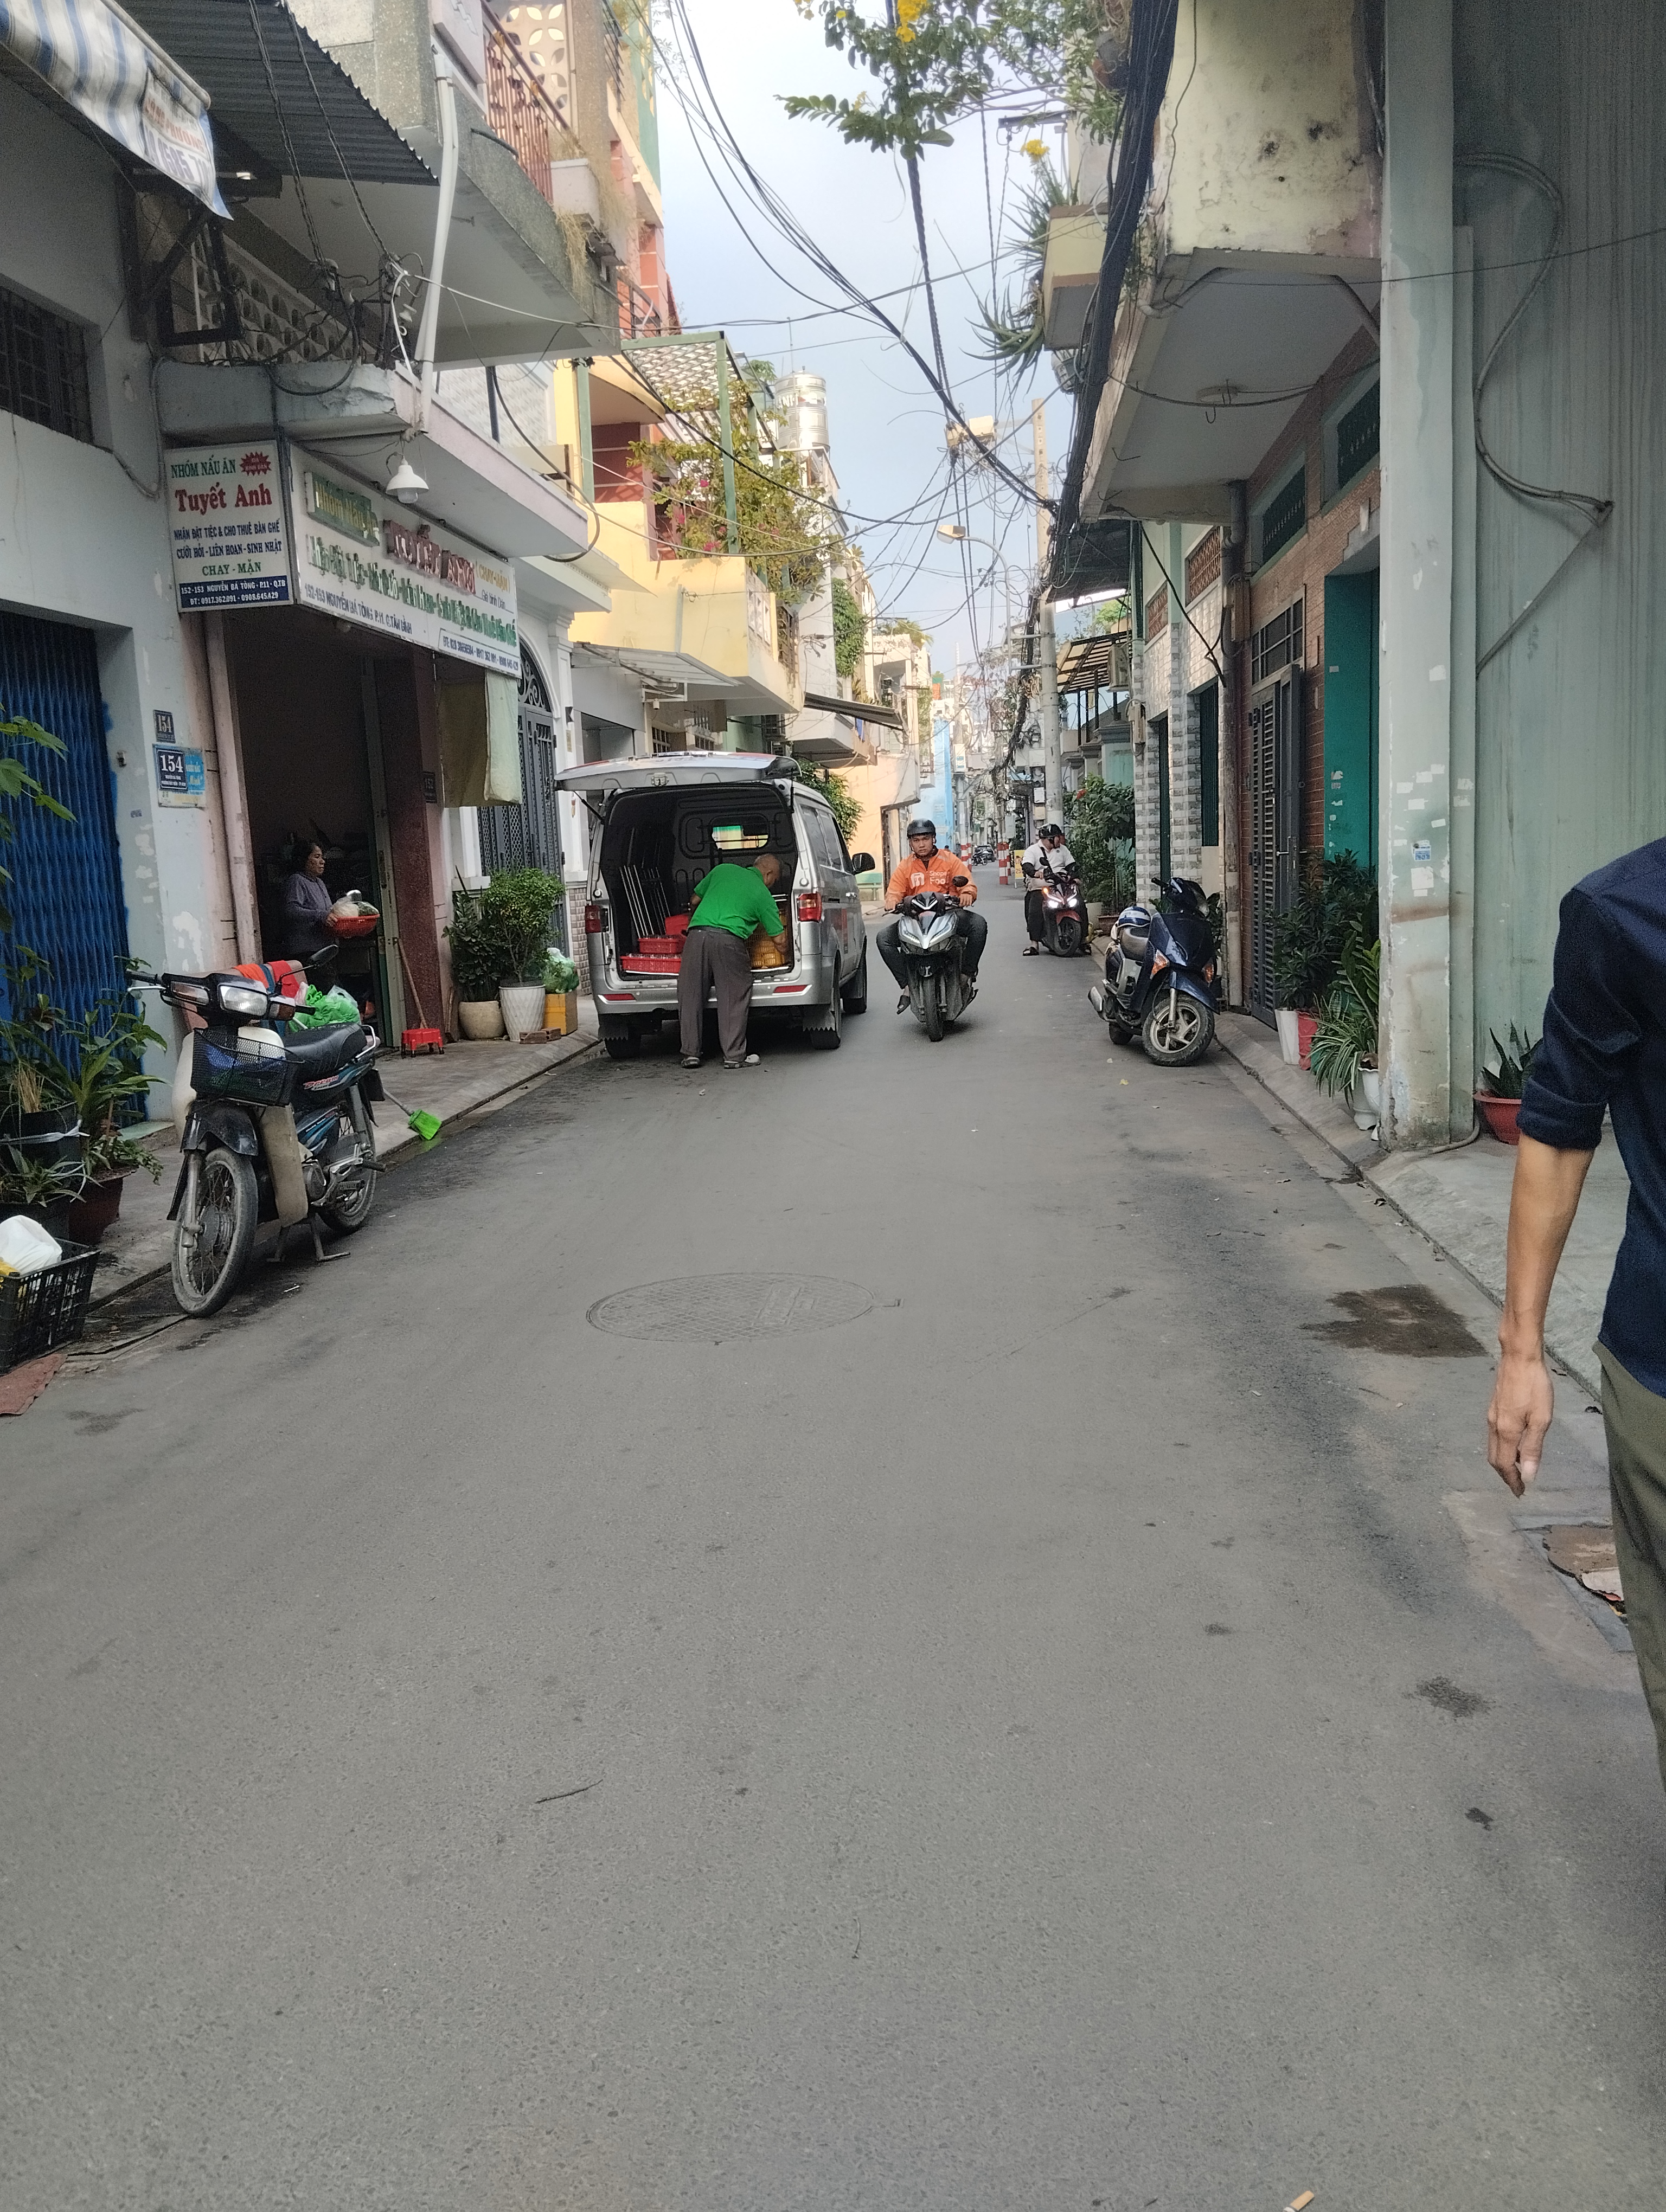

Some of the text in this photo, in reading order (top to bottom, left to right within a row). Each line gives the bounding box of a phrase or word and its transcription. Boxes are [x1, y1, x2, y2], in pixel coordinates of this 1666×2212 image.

[171, 454, 236, 478] NHÓM NẤU ĂN
[175, 482, 272, 515] Tuyết Anh
[224, 525, 236, 536] CHO
[237, 522, 253, 536] THUÊ
[254, 521, 266, 534] BÀN
[268, 518, 280, 533] GHẾ
[209, 543, 224, 557] LIÊN
[225, 544, 242, 555] HOAN
[247, 543, 263, 554] SINH
[265, 538, 281, 554] NHẬT
[202, 564, 229, 576] CHAY
[238, 558, 261, 575] MẶN
[181, 586, 204, 595] 152-153
[207, 580, 228, 592] NGUYỄN
[230, 581, 239, 590] BÁ
[240, 581, 255, 589] TÒNG
[157, 715, 172, 732] 154
[160, 754, 183, 773] 154
